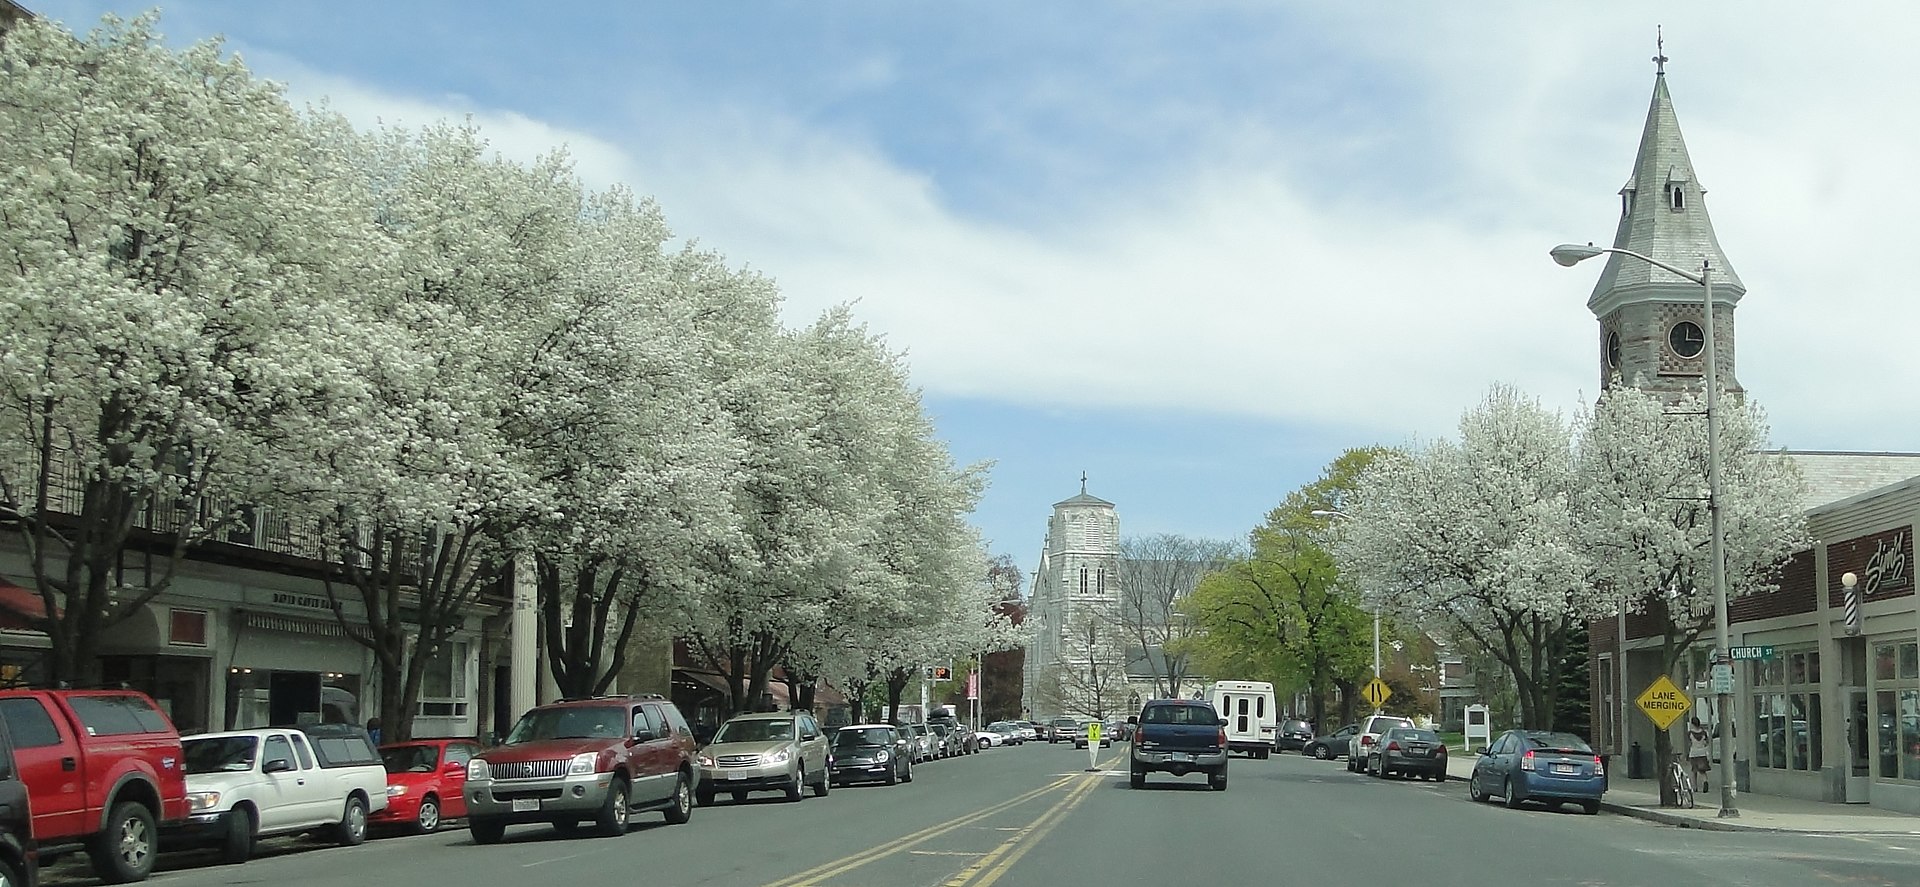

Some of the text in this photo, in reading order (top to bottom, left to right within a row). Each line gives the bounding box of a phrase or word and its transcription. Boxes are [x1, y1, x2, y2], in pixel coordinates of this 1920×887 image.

[1730, 647, 1773, 659] CHURCH ST
[1652, 692, 1676, 700] LANE
[1643, 701, 1685, 710] MERGING
